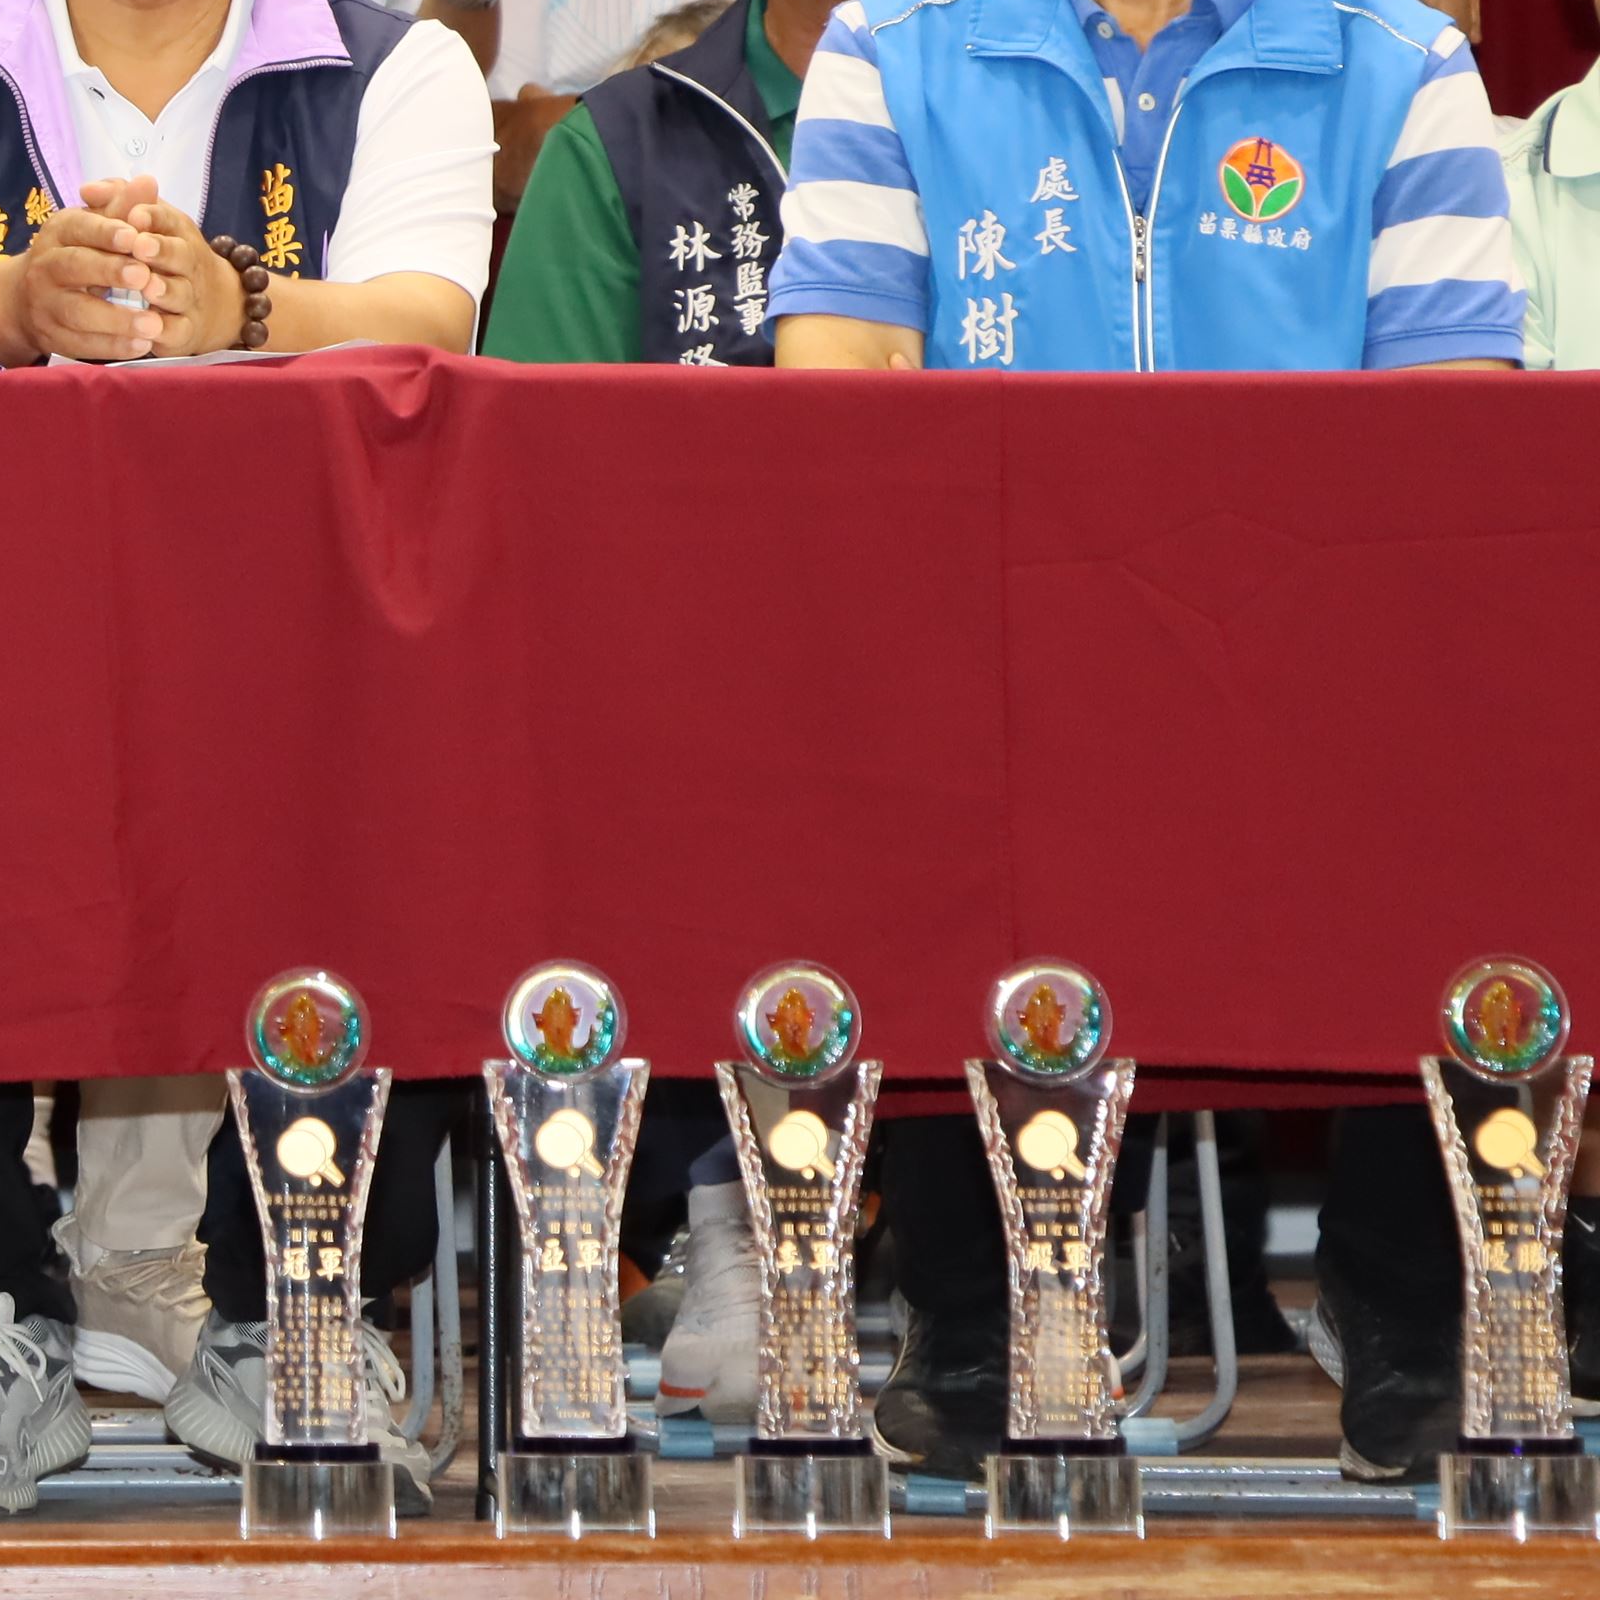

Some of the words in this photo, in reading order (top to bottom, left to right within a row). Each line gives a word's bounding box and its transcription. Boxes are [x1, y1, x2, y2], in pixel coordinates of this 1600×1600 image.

[259, 163, 303, 280] 苗栗
[1030, 156, 1080, 255] 處長
[1199, 211, 1313, 251] 苗栗縣政府
[728, 183, 770, 336] 常務監事
[958, 209, 1019, 366] 陳樹
[283, 1247, 344, 1281] 冠軍
[542, 1238, 602, 1273] 亞軍
[776, 1240, 837, 1275] 季軍
[1026, 1241, 1091, 1275] 殿軍
